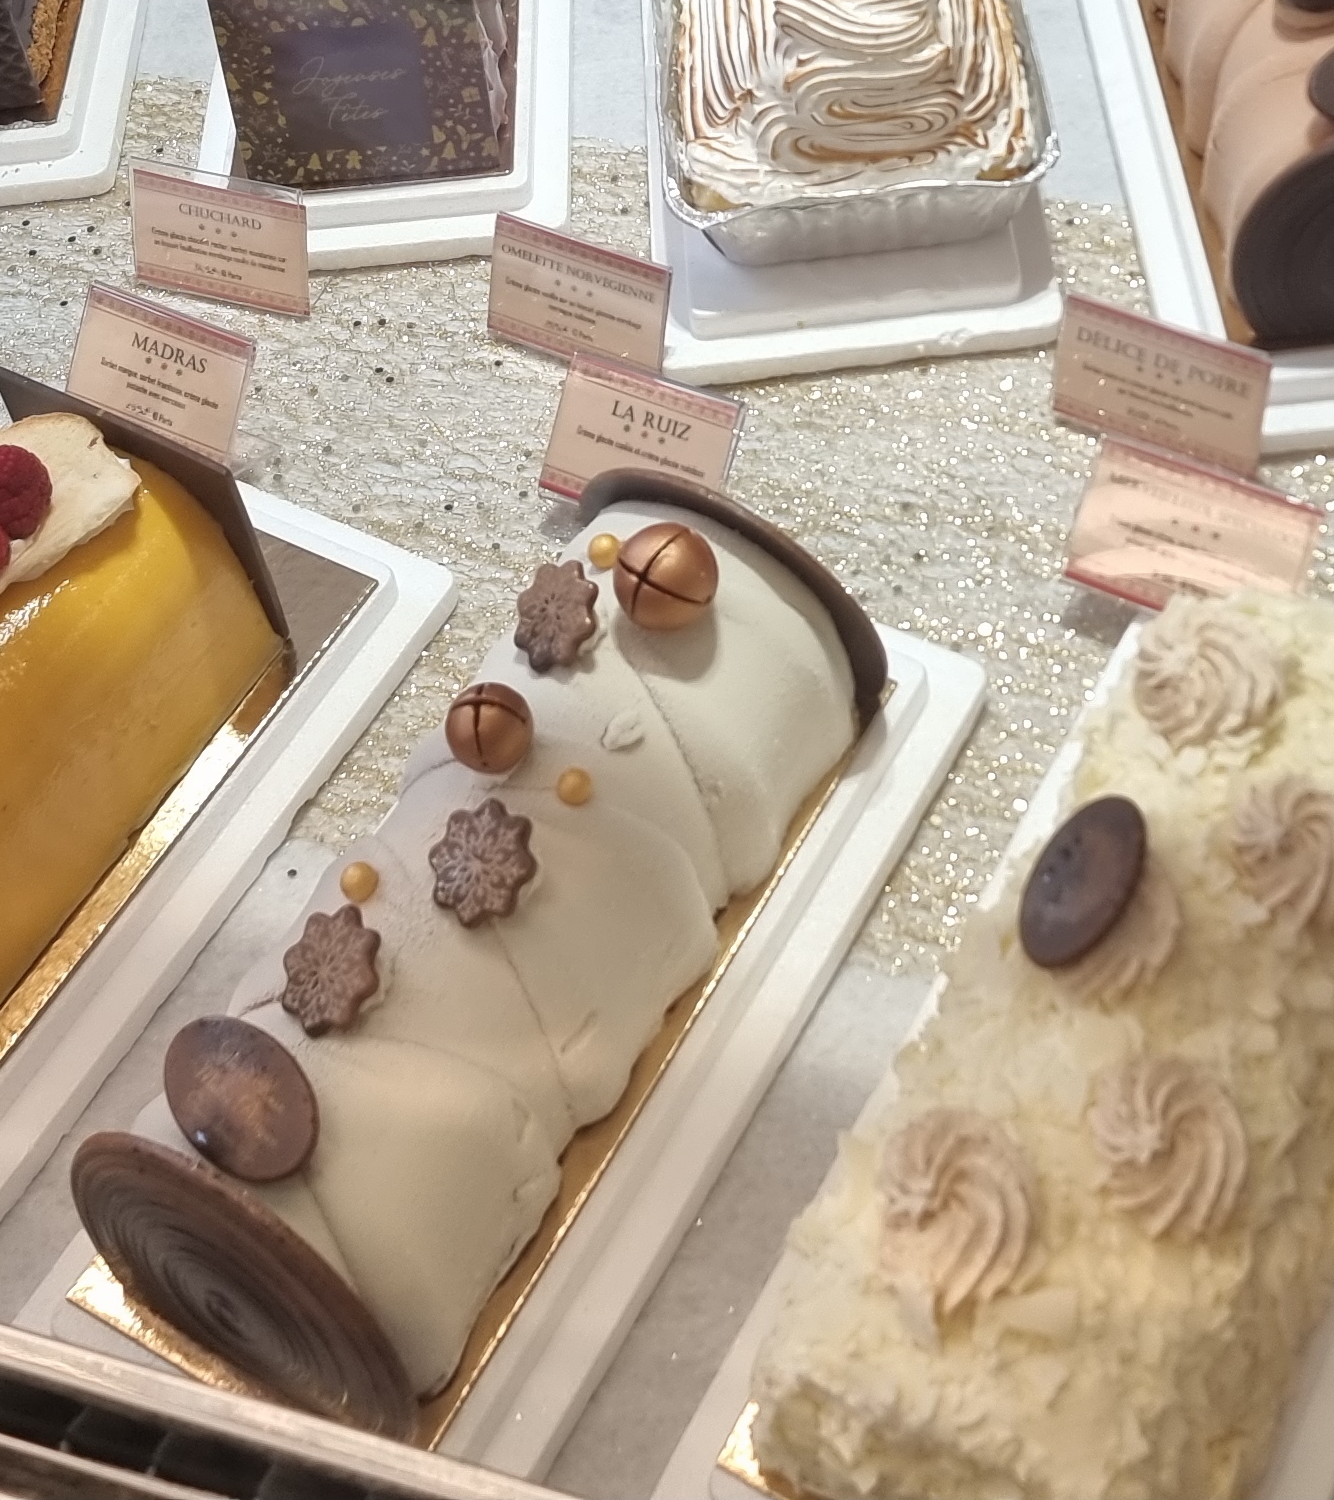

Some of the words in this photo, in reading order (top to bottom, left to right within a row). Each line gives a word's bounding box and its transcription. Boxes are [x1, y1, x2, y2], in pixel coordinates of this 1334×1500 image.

[178, 202, 262, 231] CHUCHARD
[501, 243, 564, 273] OMELETTE
[131, 332, 209, 374] MADRAS
[611, 400, 636, 423] LA
[642, 411, 693, 442] RUIZ
